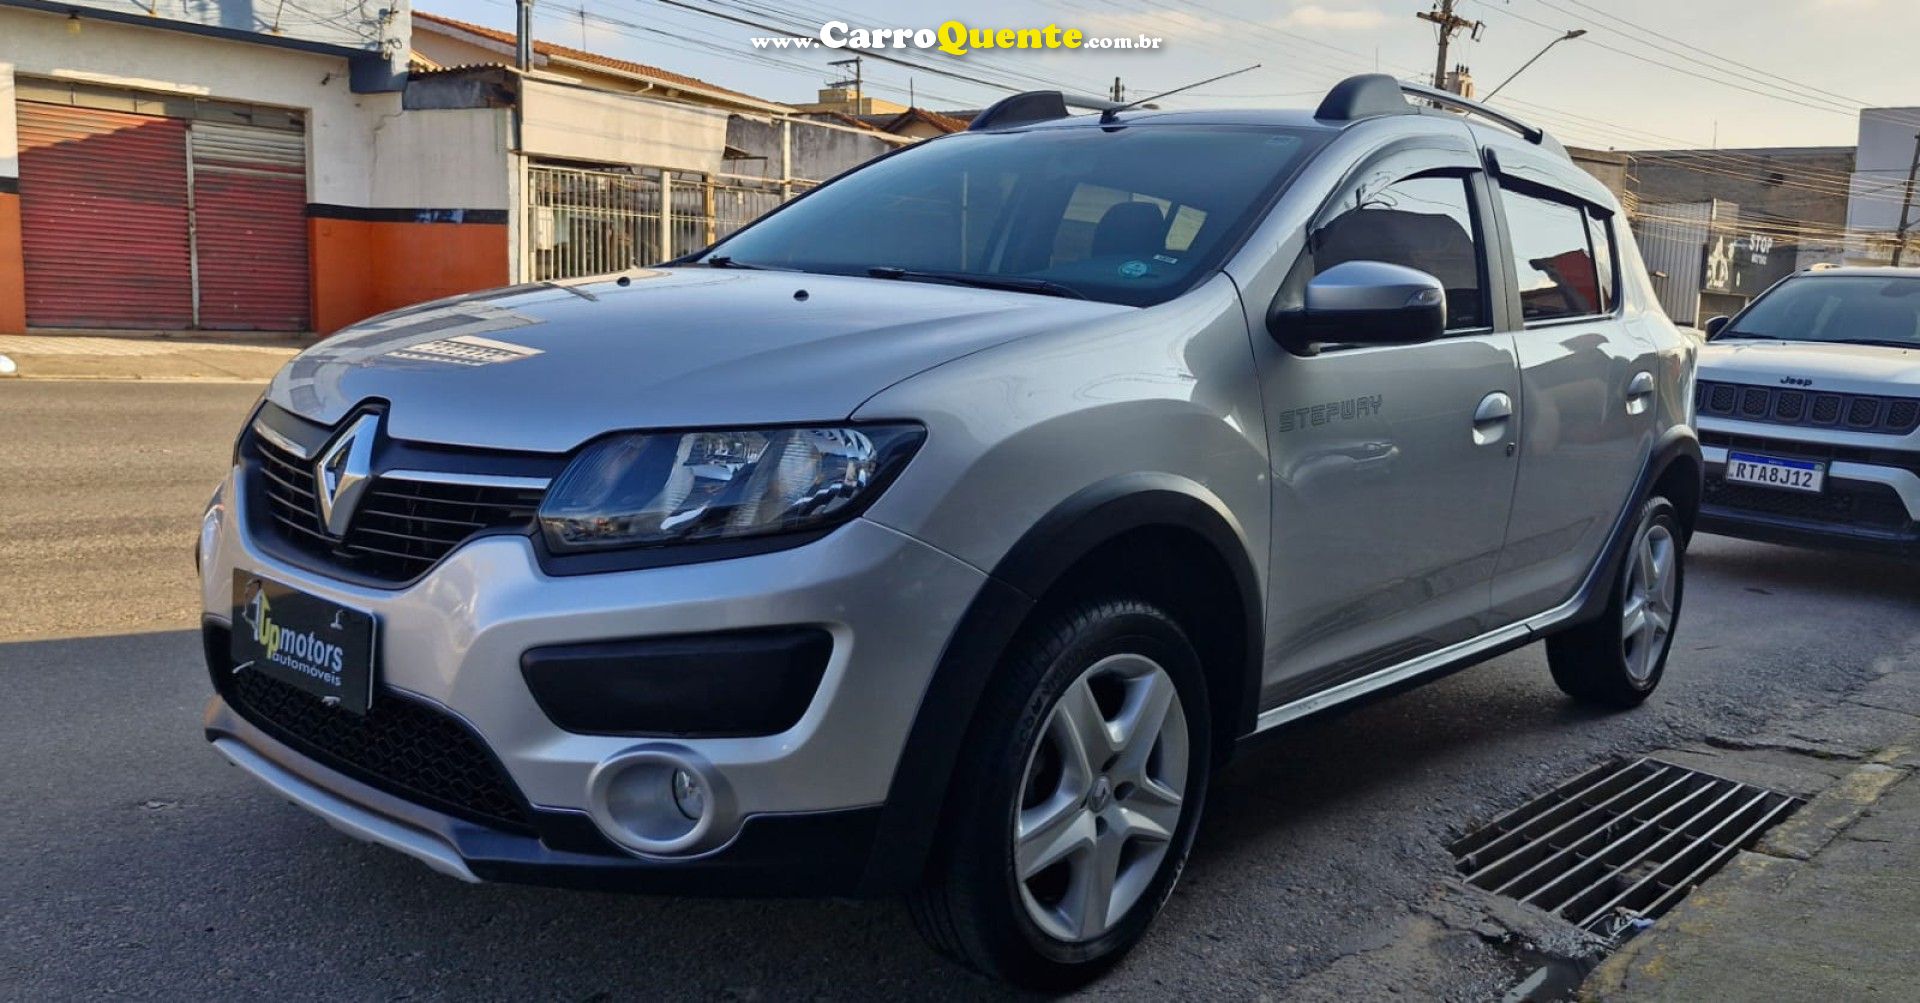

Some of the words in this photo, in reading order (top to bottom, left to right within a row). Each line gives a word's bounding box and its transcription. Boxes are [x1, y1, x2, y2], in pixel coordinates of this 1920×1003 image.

[1749, 233, 1773, 254] STOP
[1780, 375, 1813, 387] Jeep
[1279, 394, 1382, 432] STEPWAY
[1735, 462, 1813, 488] RTA8J12
[272, 652, 342, 686] automóveis
